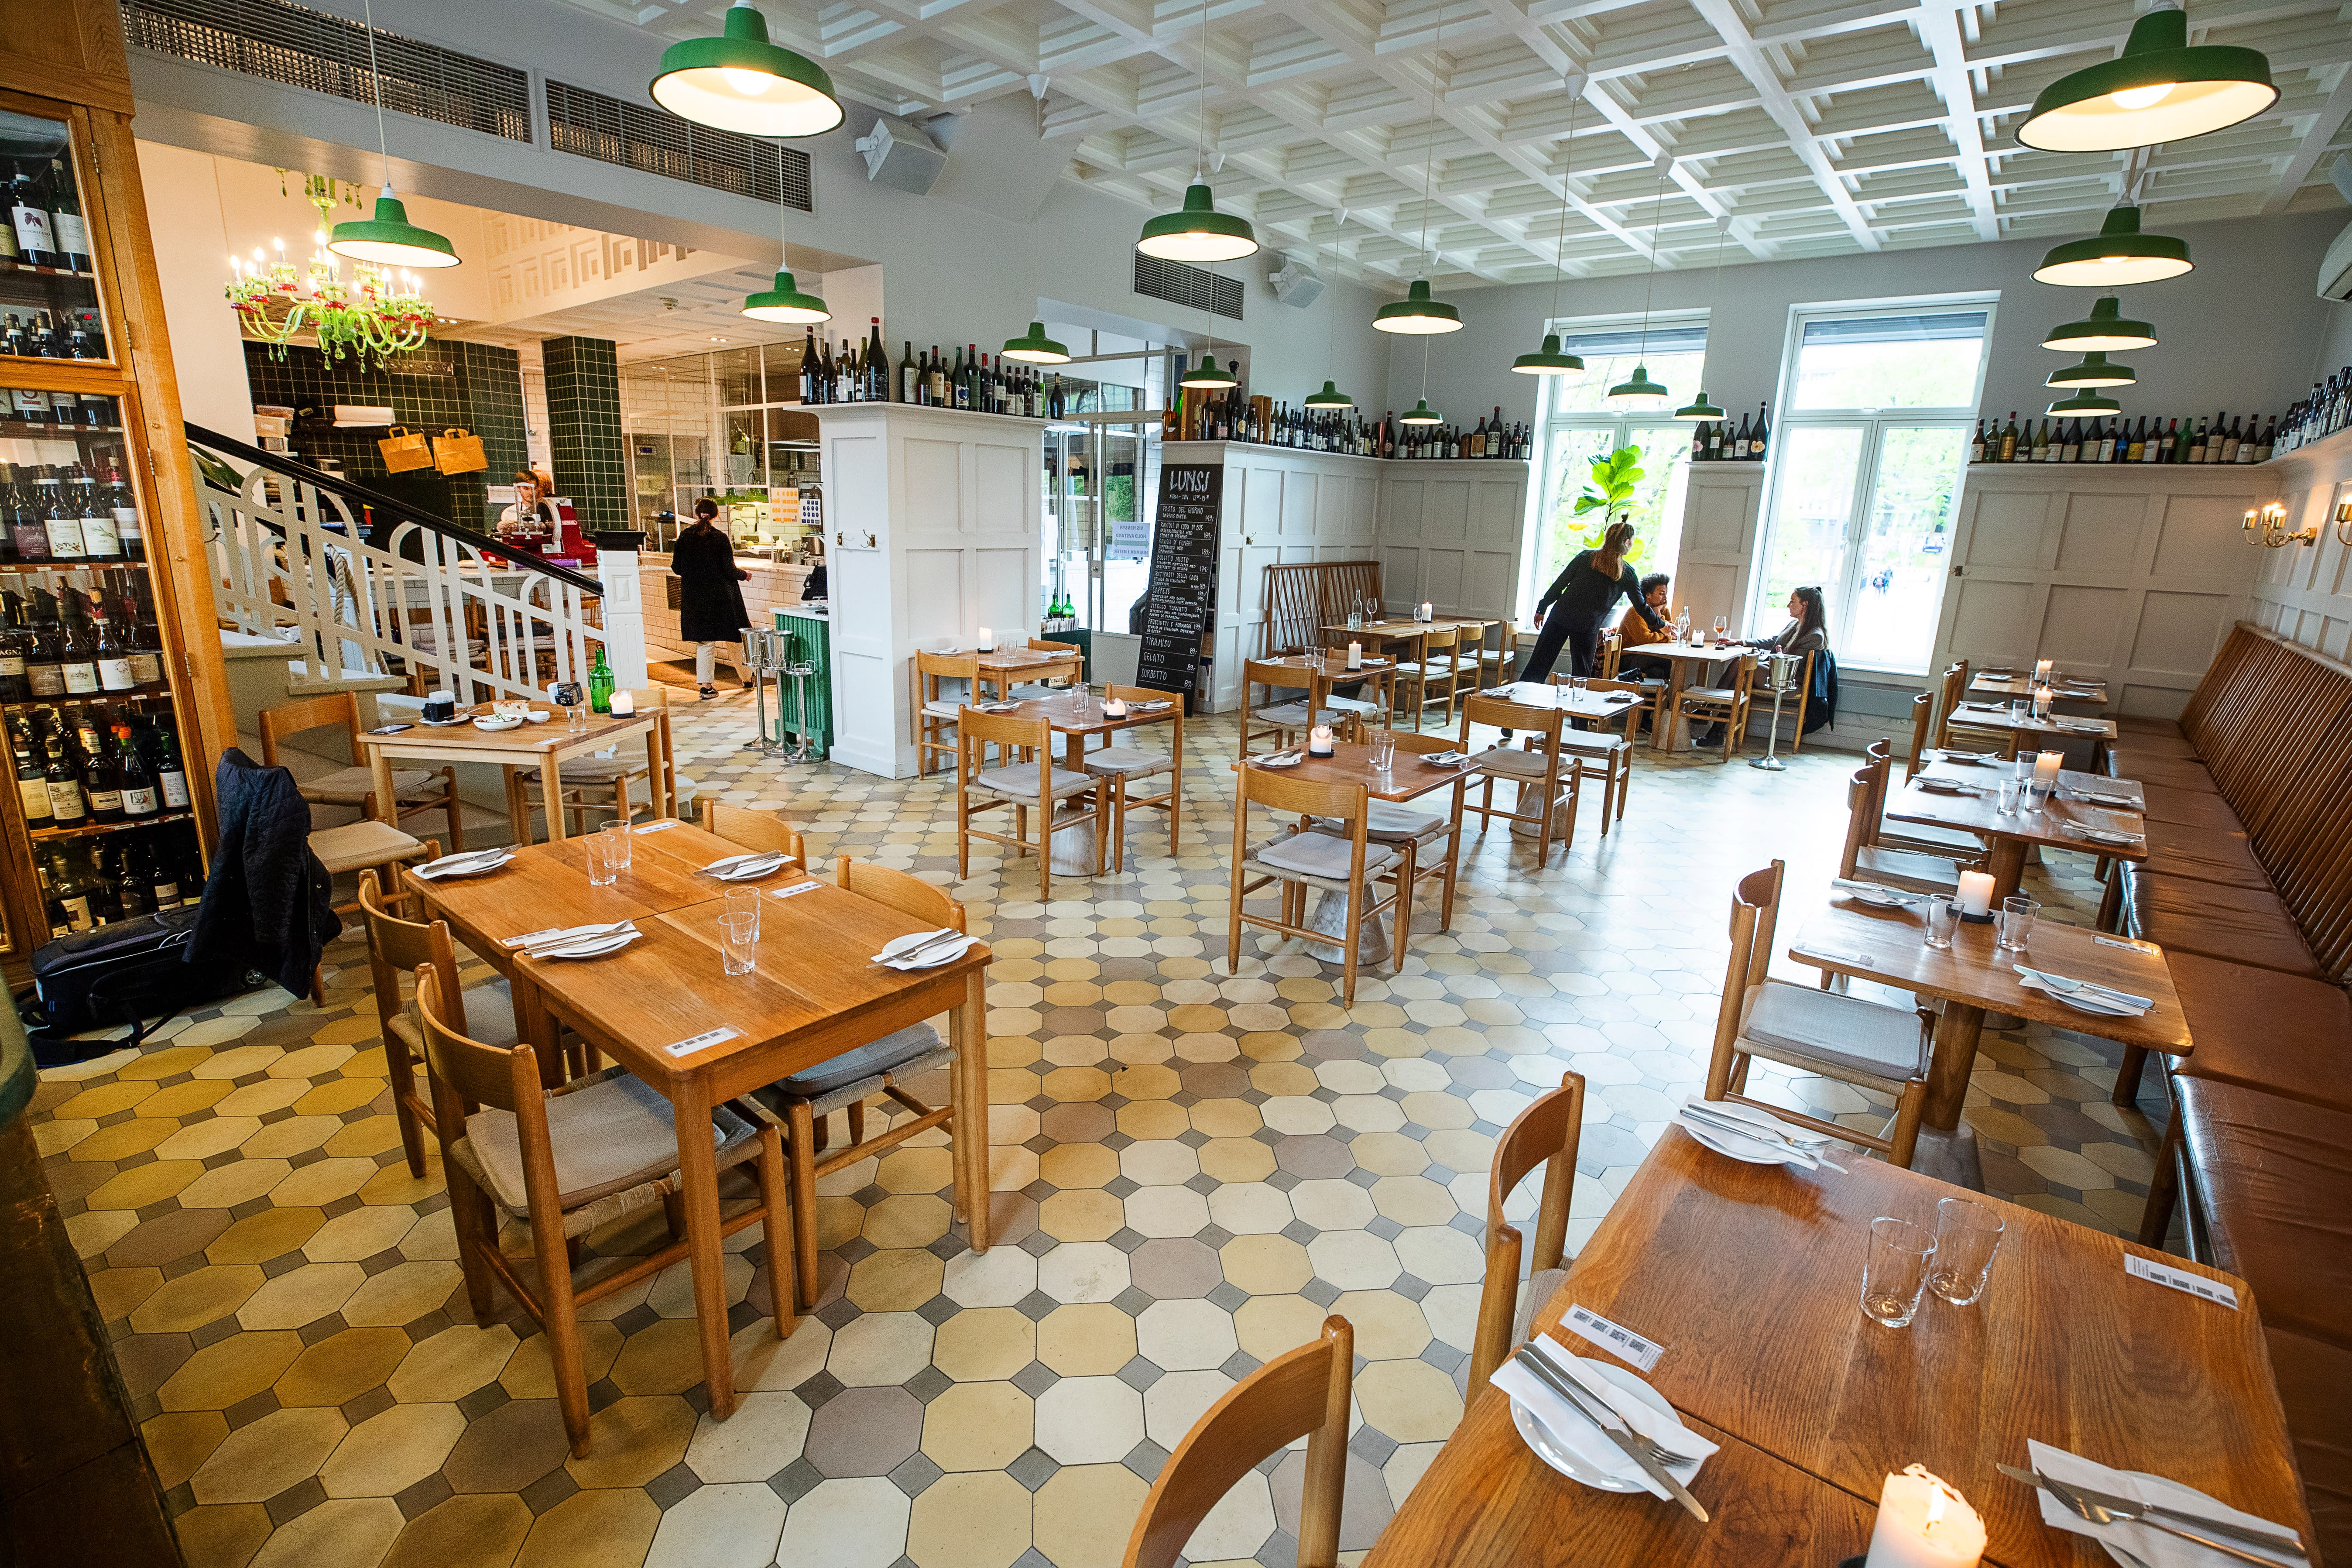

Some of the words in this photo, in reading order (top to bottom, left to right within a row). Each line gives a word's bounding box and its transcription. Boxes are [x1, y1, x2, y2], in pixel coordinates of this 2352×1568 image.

[1169, 470, 1210, 492] LUNSJ
[1146, 636, 1171, 648] TIRAMISU
[1144, 652, 1164, 663] GELATO
[1141, 668, 1167, 681] SORBETTO
